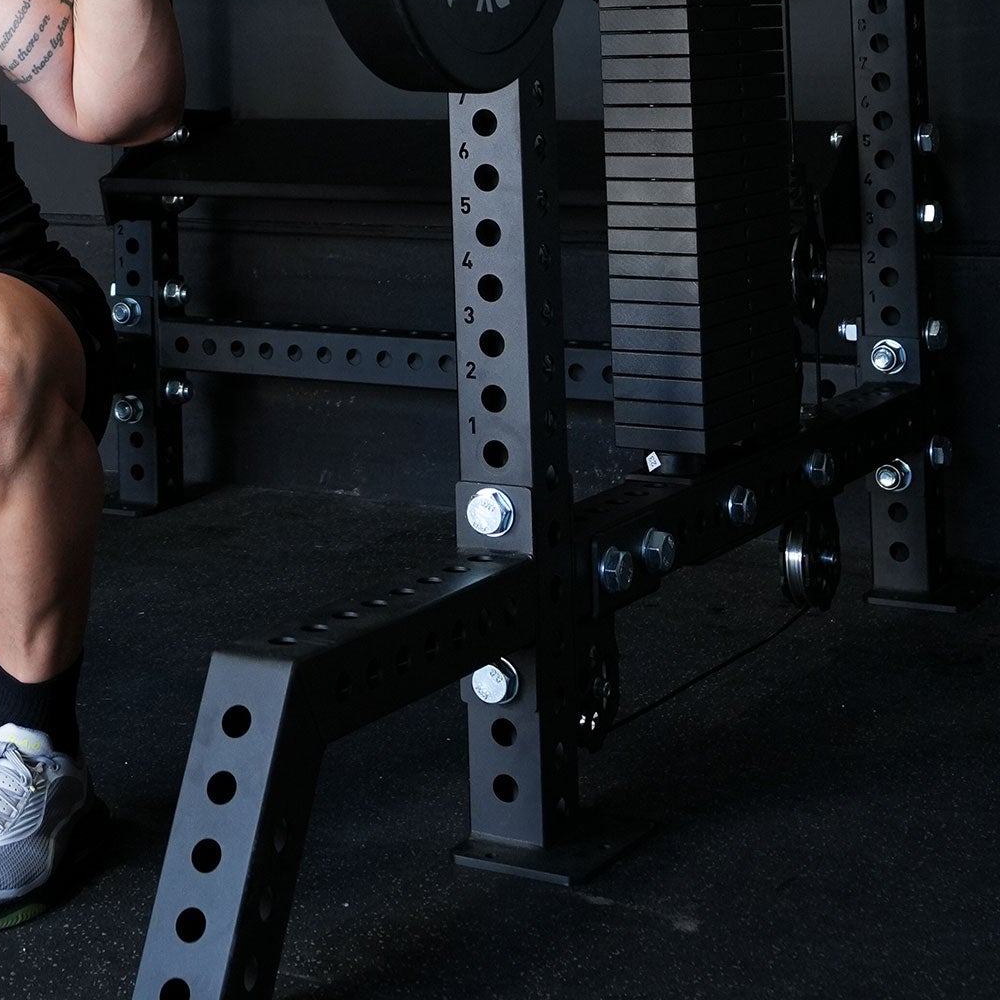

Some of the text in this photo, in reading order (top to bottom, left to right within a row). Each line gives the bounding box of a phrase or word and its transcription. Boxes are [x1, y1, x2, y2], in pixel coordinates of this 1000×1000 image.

[862, 134, 871, 147] 5
[458, 142, 469, 160] 6
[864, 173, 873, 186] 4
[460, 197, 471, 214] 5
[866, 212, 874, 224] 3
[118, 225, 124, 235] 2
[119, 257, 123, 267] 1
[461, 251, 473, 269] 4
[866, 251, 876, 264] 2
[869, 290, 876, 303] 1
[463, 306, 475, 324] 3
[466, 361, 477, 380] 2
[468, 417, 476, 434] 1
